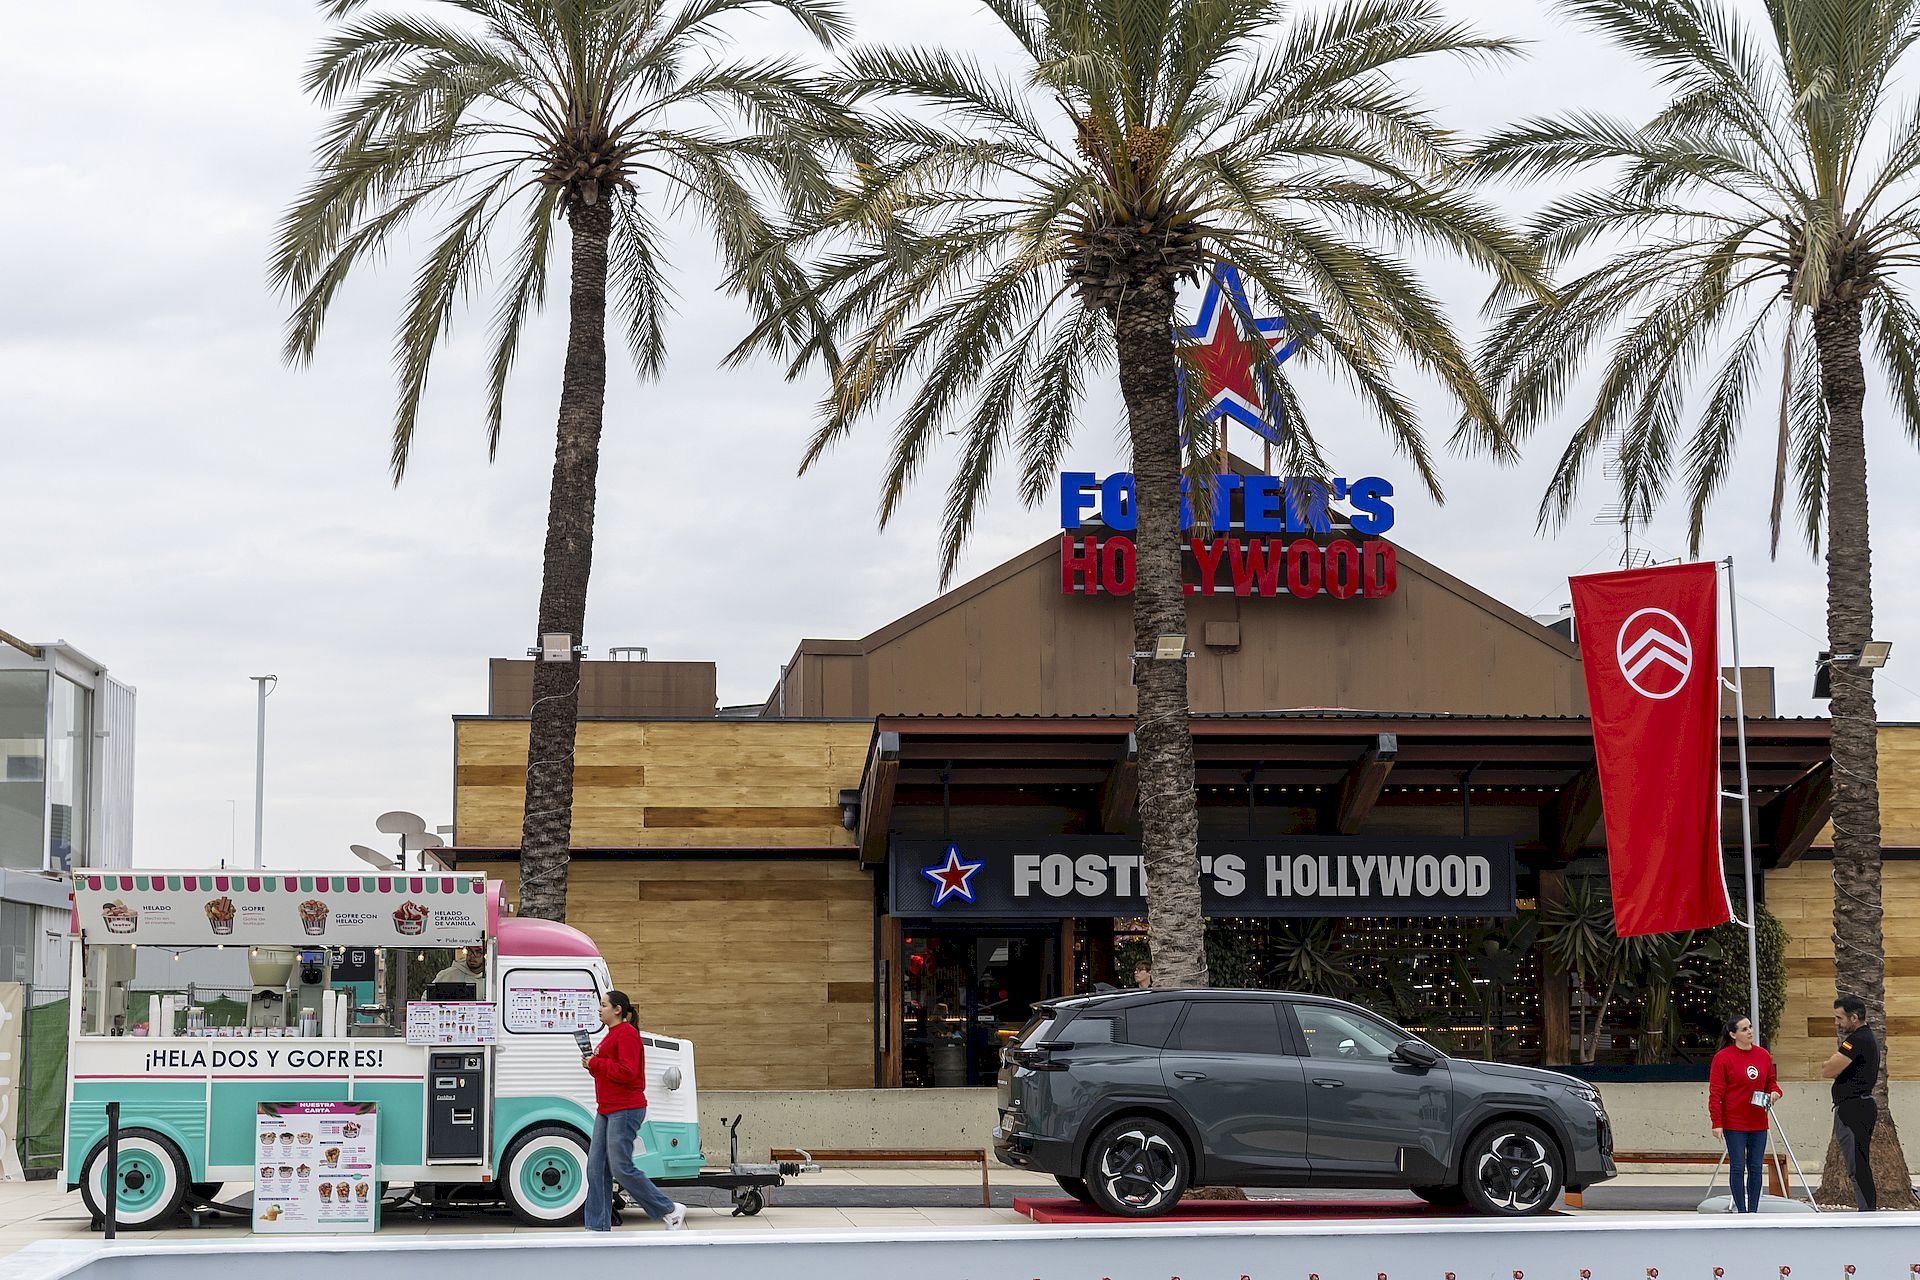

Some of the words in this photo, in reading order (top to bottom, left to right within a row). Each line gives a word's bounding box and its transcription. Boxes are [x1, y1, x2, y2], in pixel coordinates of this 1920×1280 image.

[1061, 536, 1396, 599] HOYWOOD
[1013, 854, 1246, 897] FOST'S
[1266, 854, 1490, 897] HOLLYWOOD
[145, 1049, 258, 1071] ¡HELADOS
[266, 1050, 280, 1068] Y
[287, 1049, 383, 1068] GOFRES!
